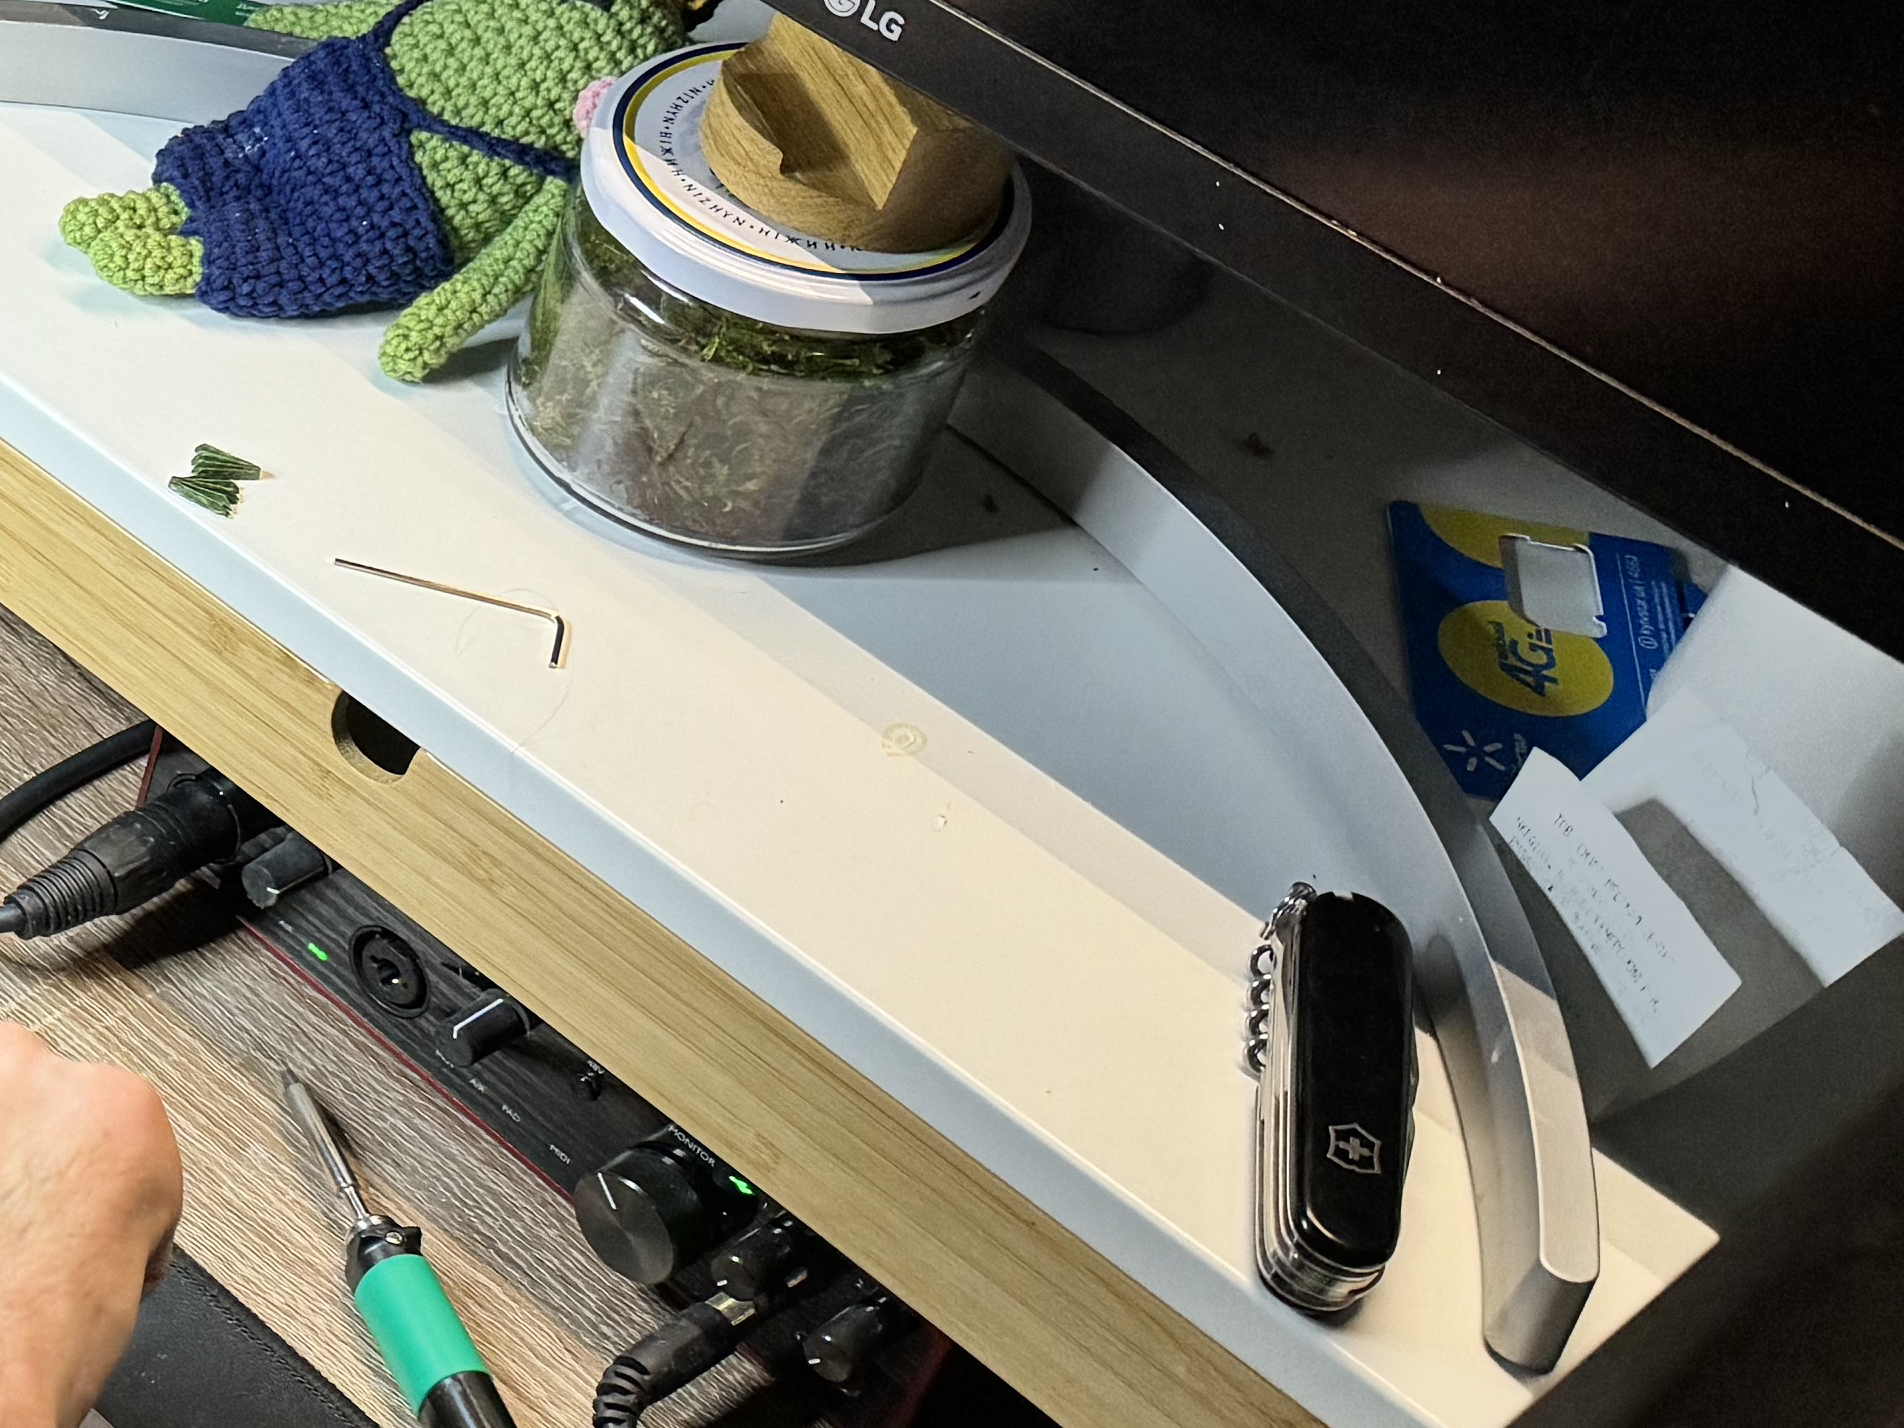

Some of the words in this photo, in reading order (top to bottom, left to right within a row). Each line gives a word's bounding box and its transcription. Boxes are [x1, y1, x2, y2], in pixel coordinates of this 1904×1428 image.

[661, 84, 702, 130] NIZHYN
[683, 182, 748, 228] NIZHYN
[758, 225, 837, 253] НІЖИН
[501, 1103, 521, 1123] PAD
[668, 1122, 716, 1168] MONITOR
